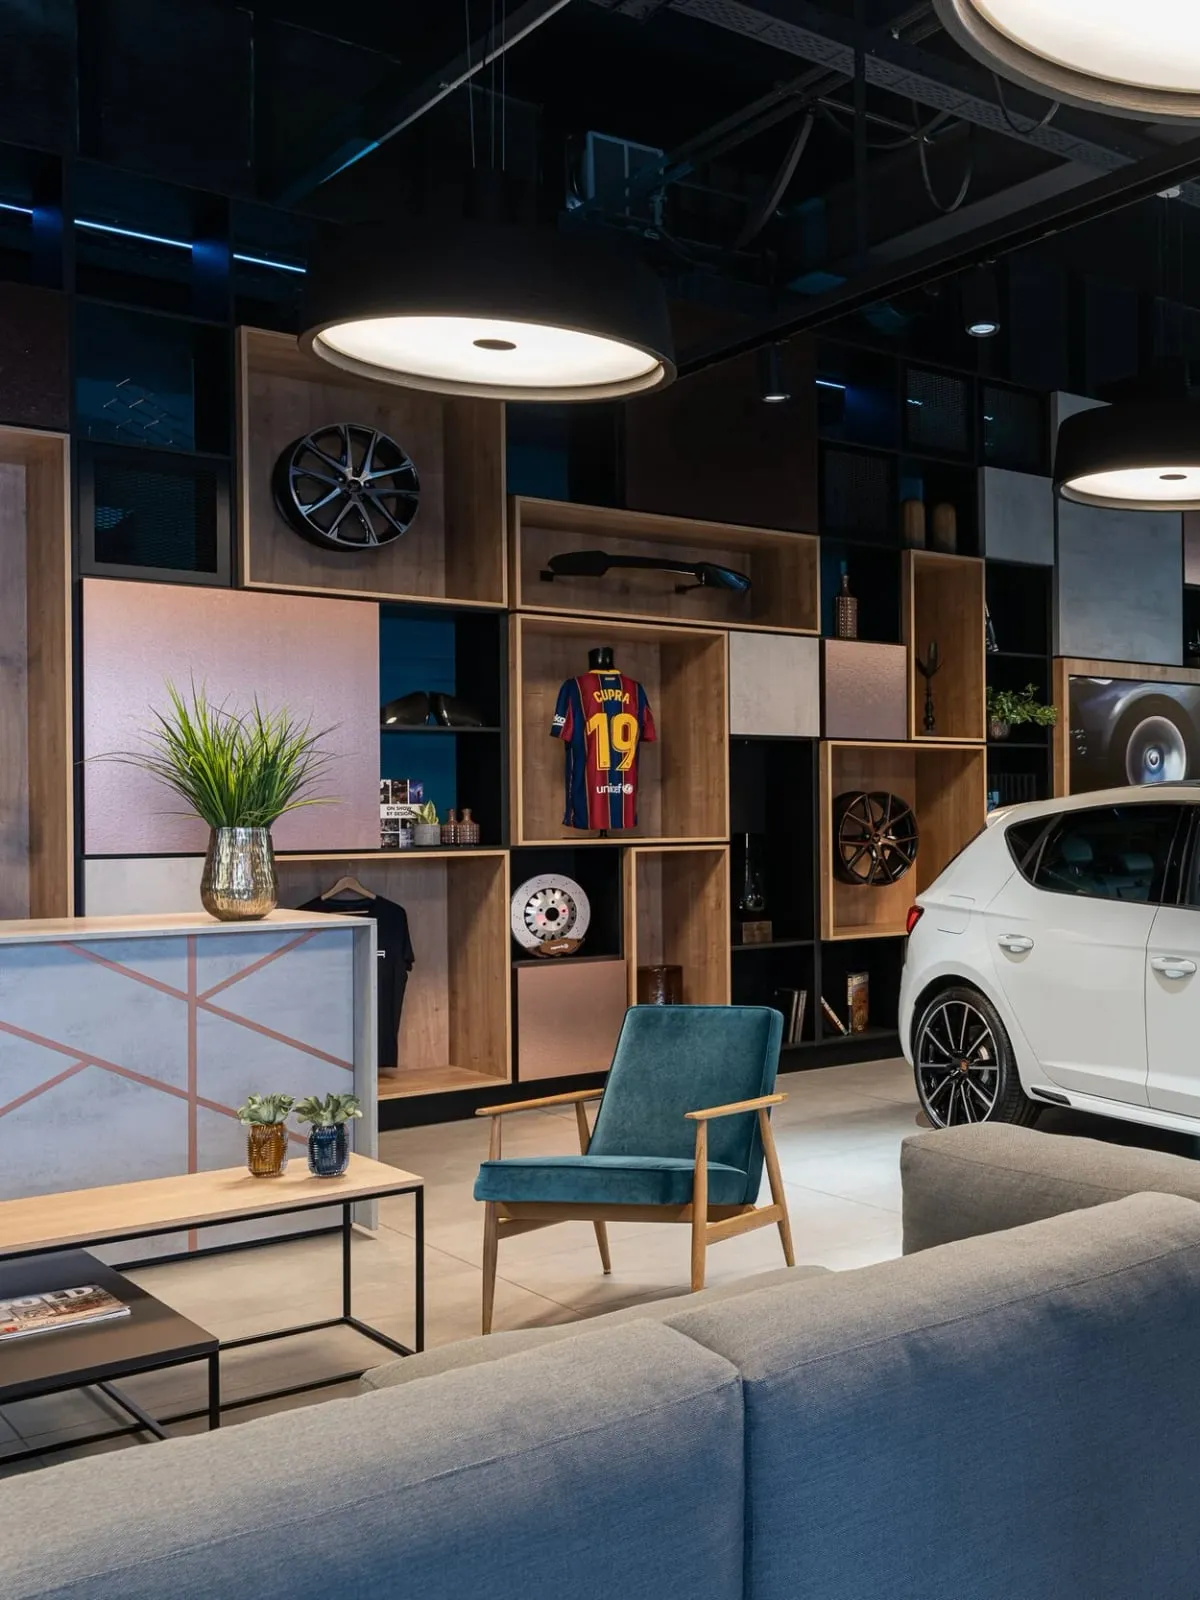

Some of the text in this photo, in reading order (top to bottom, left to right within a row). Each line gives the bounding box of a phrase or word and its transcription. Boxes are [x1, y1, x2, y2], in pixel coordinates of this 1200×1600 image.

[593, 689, 630, 704] CUPRA
[587, 713, 639, 771] 19
[596, 783, 622, 794] unicef
[0, 1286, 95, 1312] OLD
